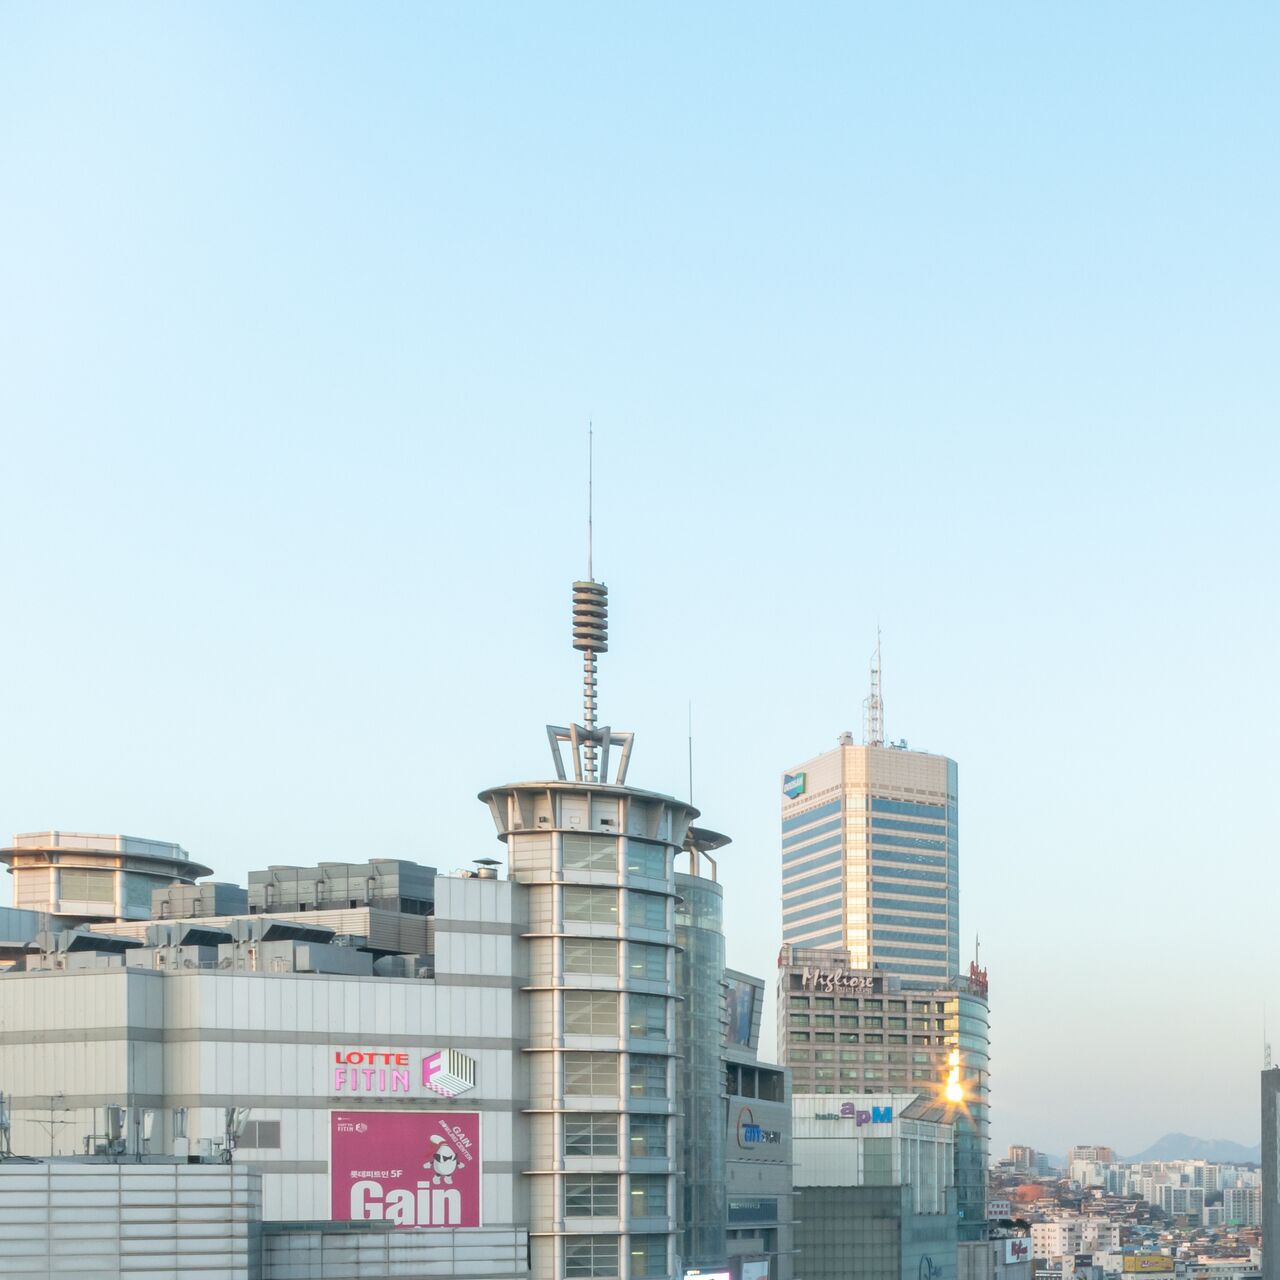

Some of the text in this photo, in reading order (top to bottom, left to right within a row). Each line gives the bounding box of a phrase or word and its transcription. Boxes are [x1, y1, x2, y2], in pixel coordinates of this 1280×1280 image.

[801, 966, 874, 993] Migliore
[335, 1051, 410, 1066] LOTTE
[335, 1068, 410, 1092] FITIN
[452, 1126, 473, 1148] GAIN
[390, 1169, 404, 1178] 5F
[350, 1180, 462, 1226] Gain
